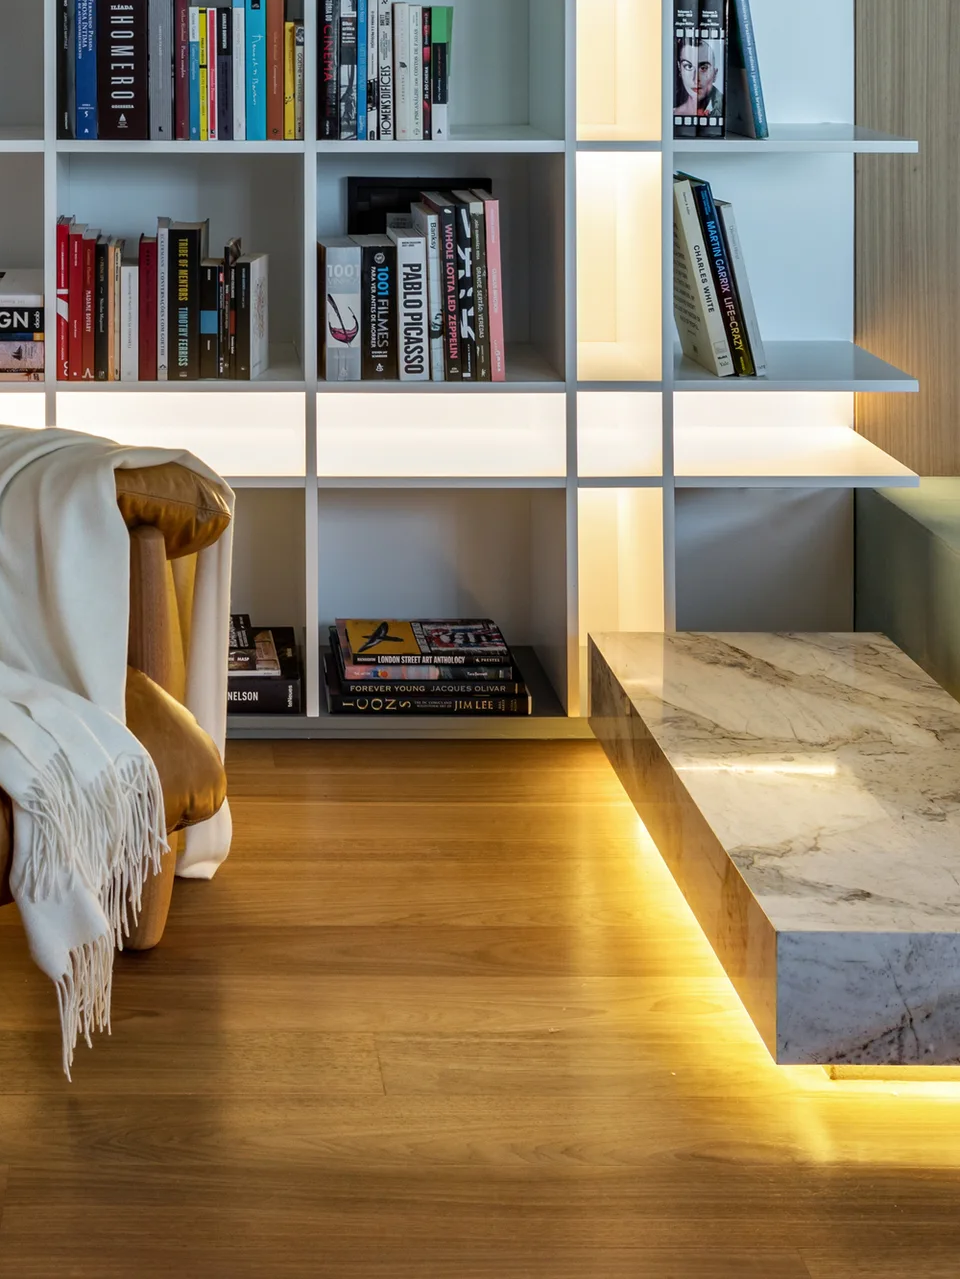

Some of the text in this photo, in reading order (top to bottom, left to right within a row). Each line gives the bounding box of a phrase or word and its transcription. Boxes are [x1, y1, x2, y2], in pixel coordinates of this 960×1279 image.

[81, 21, 89, 48] ÍNTIMA
[324, 14, 333, 22] DO
[109, 15, 135, 100] HOMERO
[322, 24, 334, 83] CINEMA
[379, 65, 392, 135] HOMENS DIFÍCEIS
[428, 222, 438, 250] Banksy
[178, 238, 189, 302] TRIBE OF MENTORS
[444, 223, 459, 359] WHOLE LOTTA LED ZEPPELIN
[693, 244, 715, 313] CHARLES WHITE
[705, 219, 744, 352] MARTIN GARRIX LIFE=CRAZY
[84, 289, 92, 333] MADAME BOVARY
[370, 314, 377, 323] DE
[376, 266, 390, 348] 1001 FILMES
[402, 263, 425, 374] PABLO PICASSO
[474, 266, 485, 339] GRANDE SERTÃO: VEREDAS
[177, 306, 189, 367] TIMOTHY FERRISS
[349, 684, 392, 693] FOREVER
[393, 685, 426, 693] YOUNG
[430, 684, 473, 693] JACQUES
[377, 655, 466, 665] LONDON STREET ART ANTHOLOGY
[227, 691, 259, 701] NELSON
[342, 697, 412, 711] ICONS
[453, 699, 474, 711] JIM
[474, 700, 494, 710] LEE
